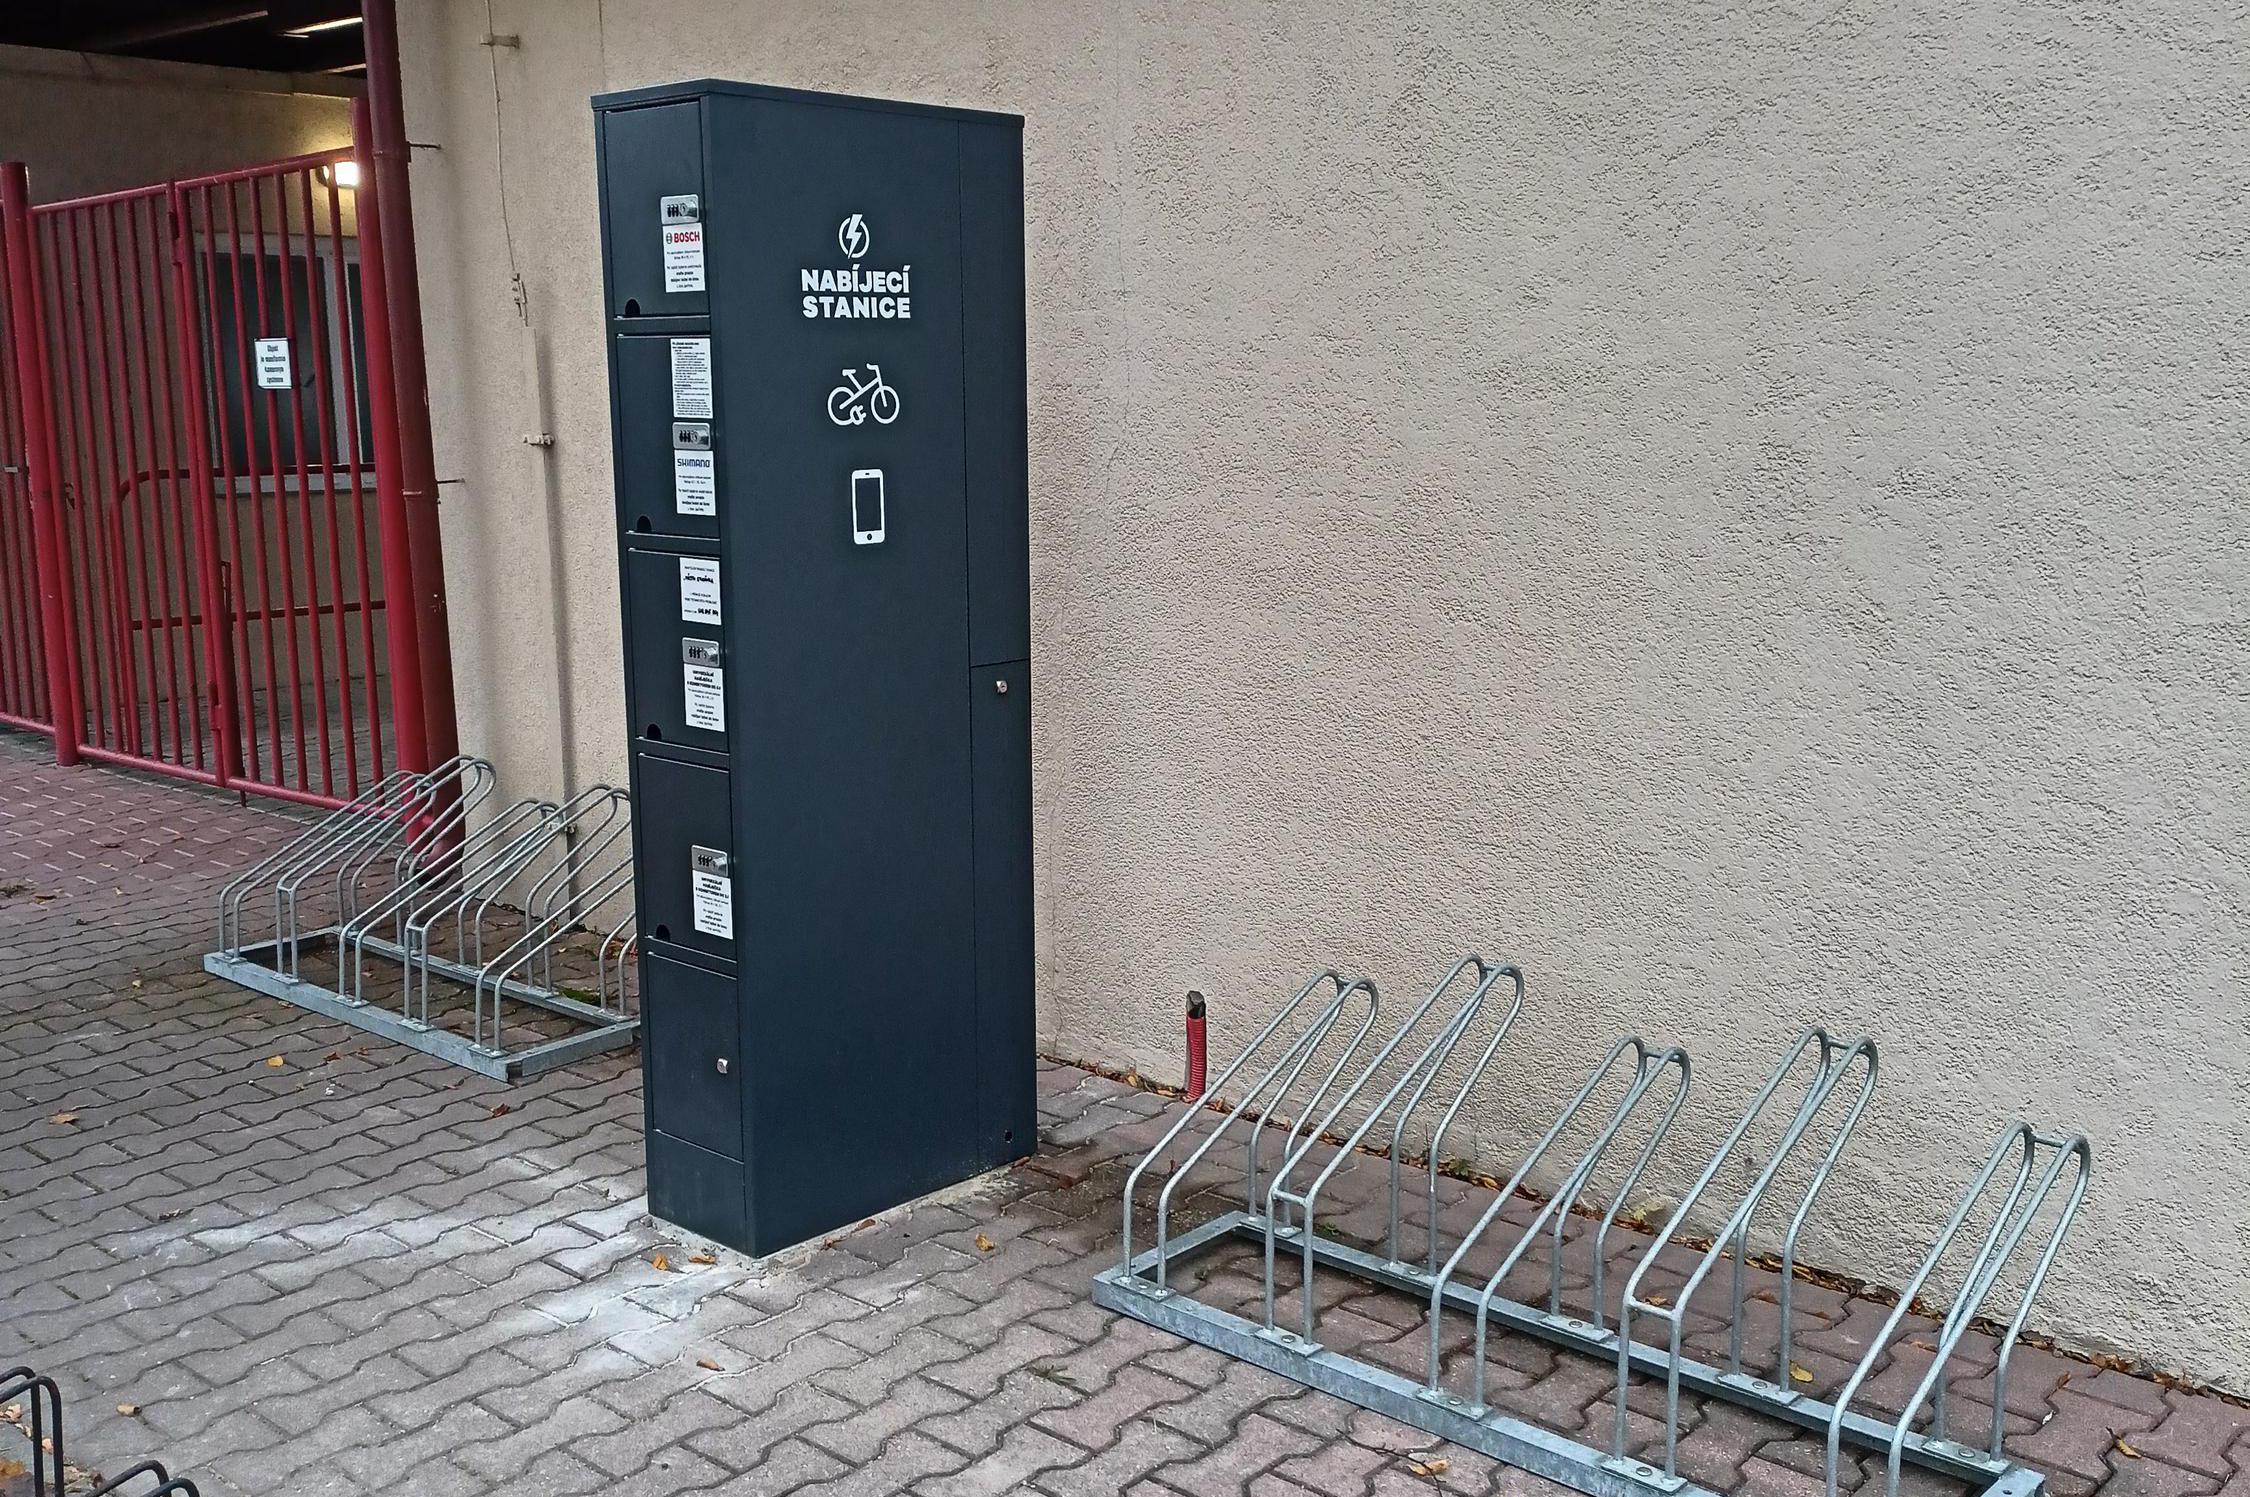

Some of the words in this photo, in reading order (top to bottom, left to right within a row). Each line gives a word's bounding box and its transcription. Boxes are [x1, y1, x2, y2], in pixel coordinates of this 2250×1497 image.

[673, 231, 700, 243] BOSCH
[801, 264, 911, 293] NABÍJECÍ
[802, 296, 911, 319] STANICE
[677, 458, 711, 468] SHIMANO
